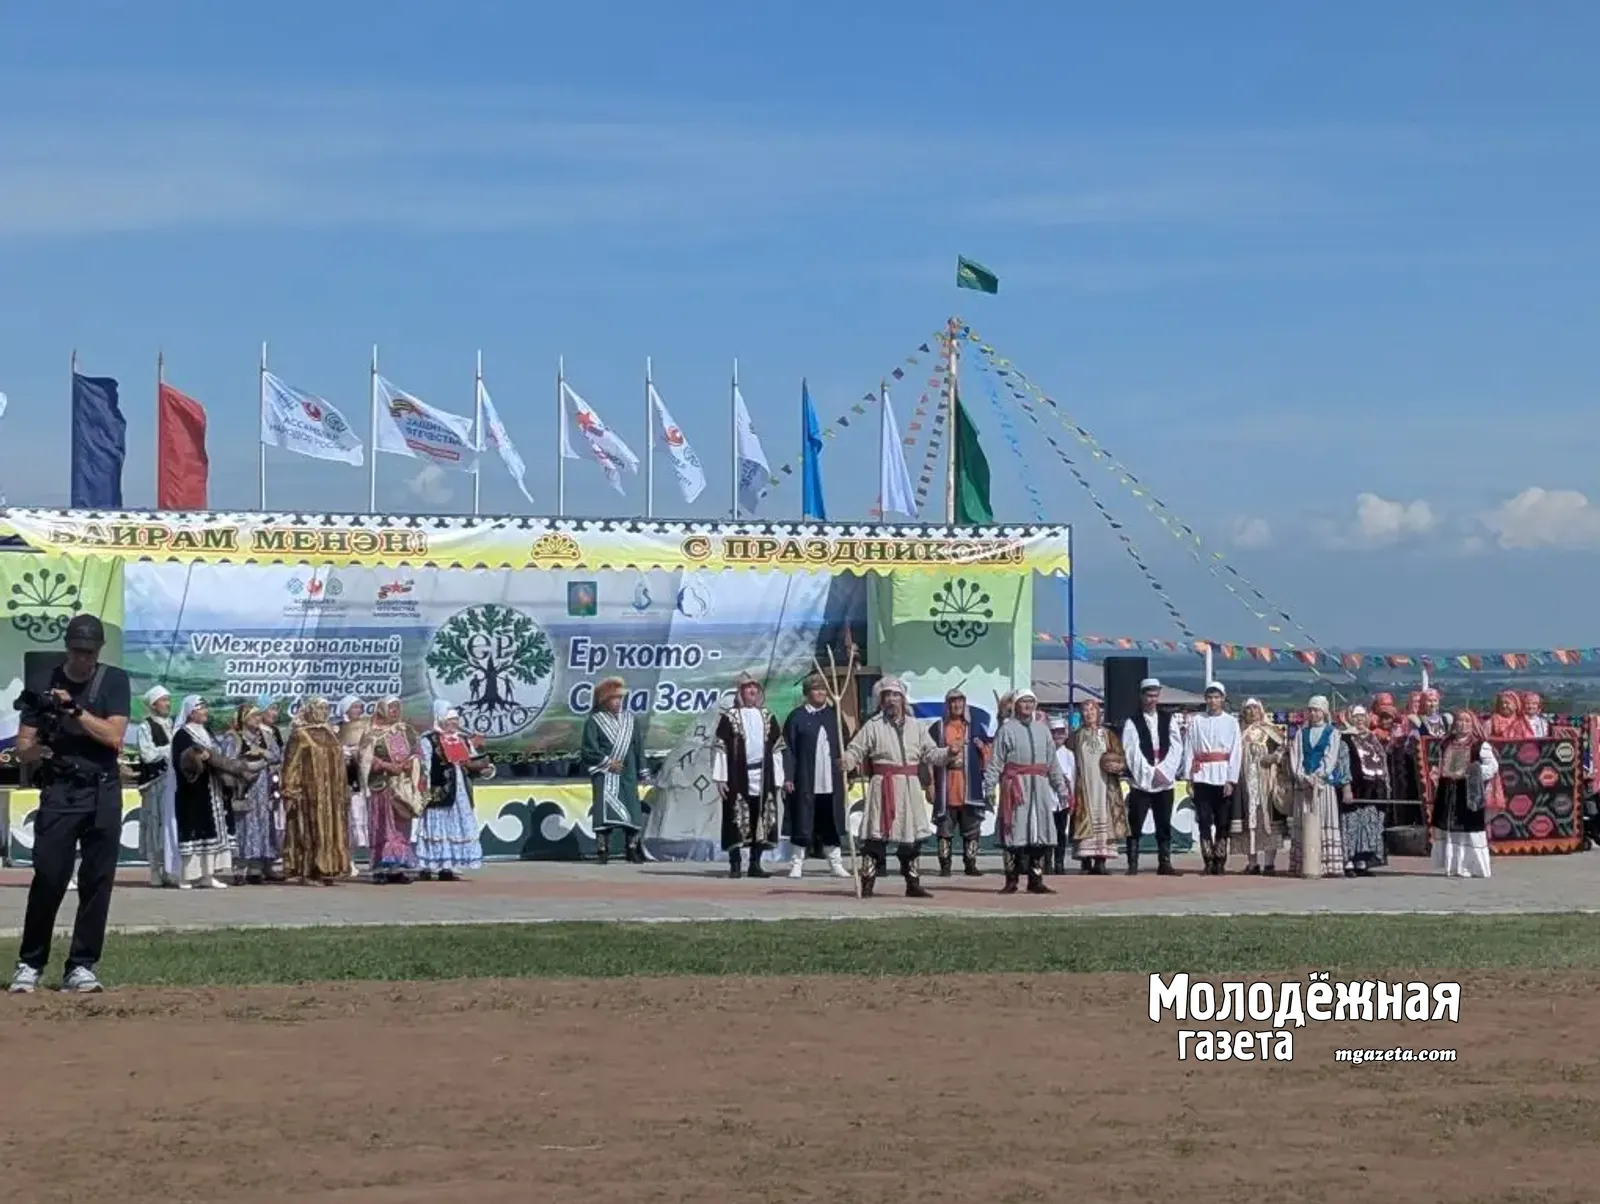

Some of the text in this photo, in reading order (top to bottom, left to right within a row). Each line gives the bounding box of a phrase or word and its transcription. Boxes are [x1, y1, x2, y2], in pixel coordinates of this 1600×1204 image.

[49, 523, 238, 551] БАЙРАМ
[682, 536, 1026, 564] С ПРАЗДНИКОМ!
[193, 635, 400, 655] V Межрегиональный
[570, 638, 607, 672] Ер
[227, 658, 400, 677] этнокультурный
[228, 679, 400, 698] патриотический
